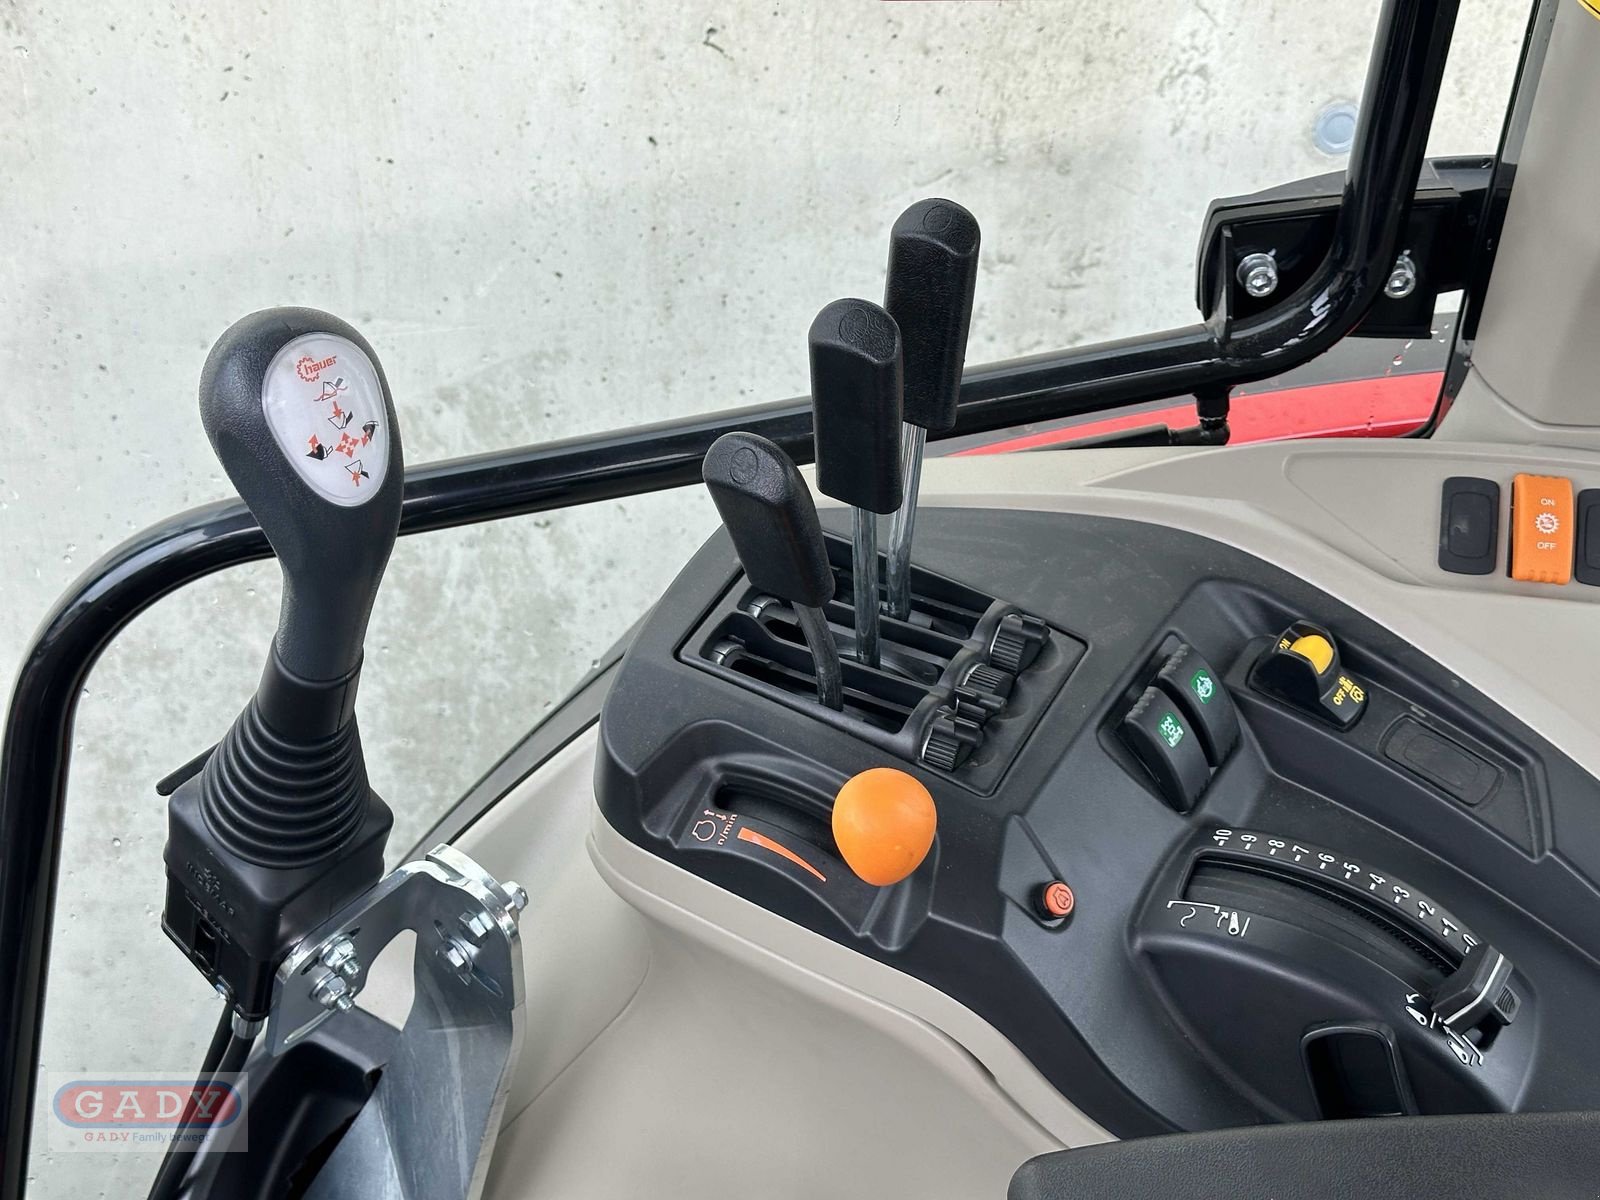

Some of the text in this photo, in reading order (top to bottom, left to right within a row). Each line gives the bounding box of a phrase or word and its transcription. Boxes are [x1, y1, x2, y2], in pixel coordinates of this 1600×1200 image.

[304, 356, 337, 375] hauer
[1540, 498, 1556, 507] ON
[1536, 541, 1557, 551] OFF
[1333, 688, 1347, 706] OFF
[717, 814, 738, 846] n/min
[1212, 829, 1233, 841] 10
[1240, 834, 1258, 842] 9
[1267, 839, 1286, 849] 8
[1291, 844, 1310, 854] 7
[1317, 853, 1335, 863] 6
[1343, 862, 1361, 873] 5
[1369, 873, 1386, 885] 4
[1393, 885, 1410, 898] 3
[1418, 900, 1435, 916] 2
[1442, 917, 1459, 931] 1
